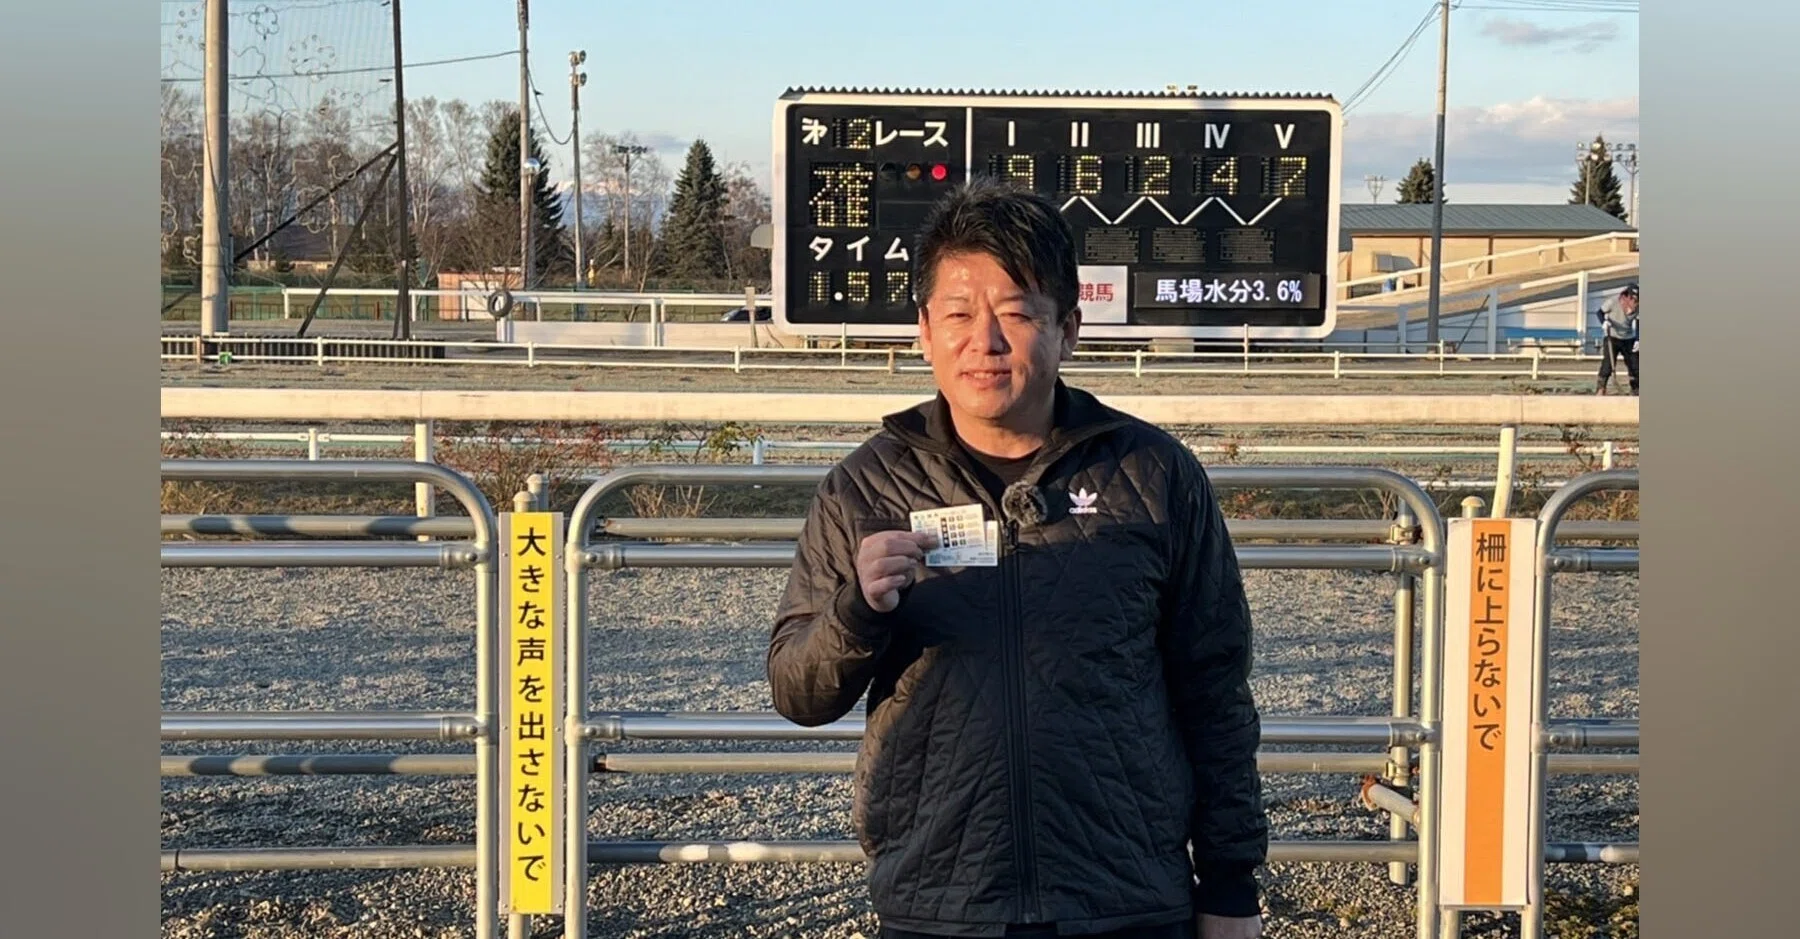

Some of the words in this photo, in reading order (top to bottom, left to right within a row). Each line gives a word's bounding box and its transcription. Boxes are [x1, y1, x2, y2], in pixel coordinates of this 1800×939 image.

[809, 162, 874, 227] 確
[1274, 123, 1295, 149] V
[517, 527, 547, 881] 大きな声を出さないで
[1473, 532, 1507, 751] 柵に上らないで
